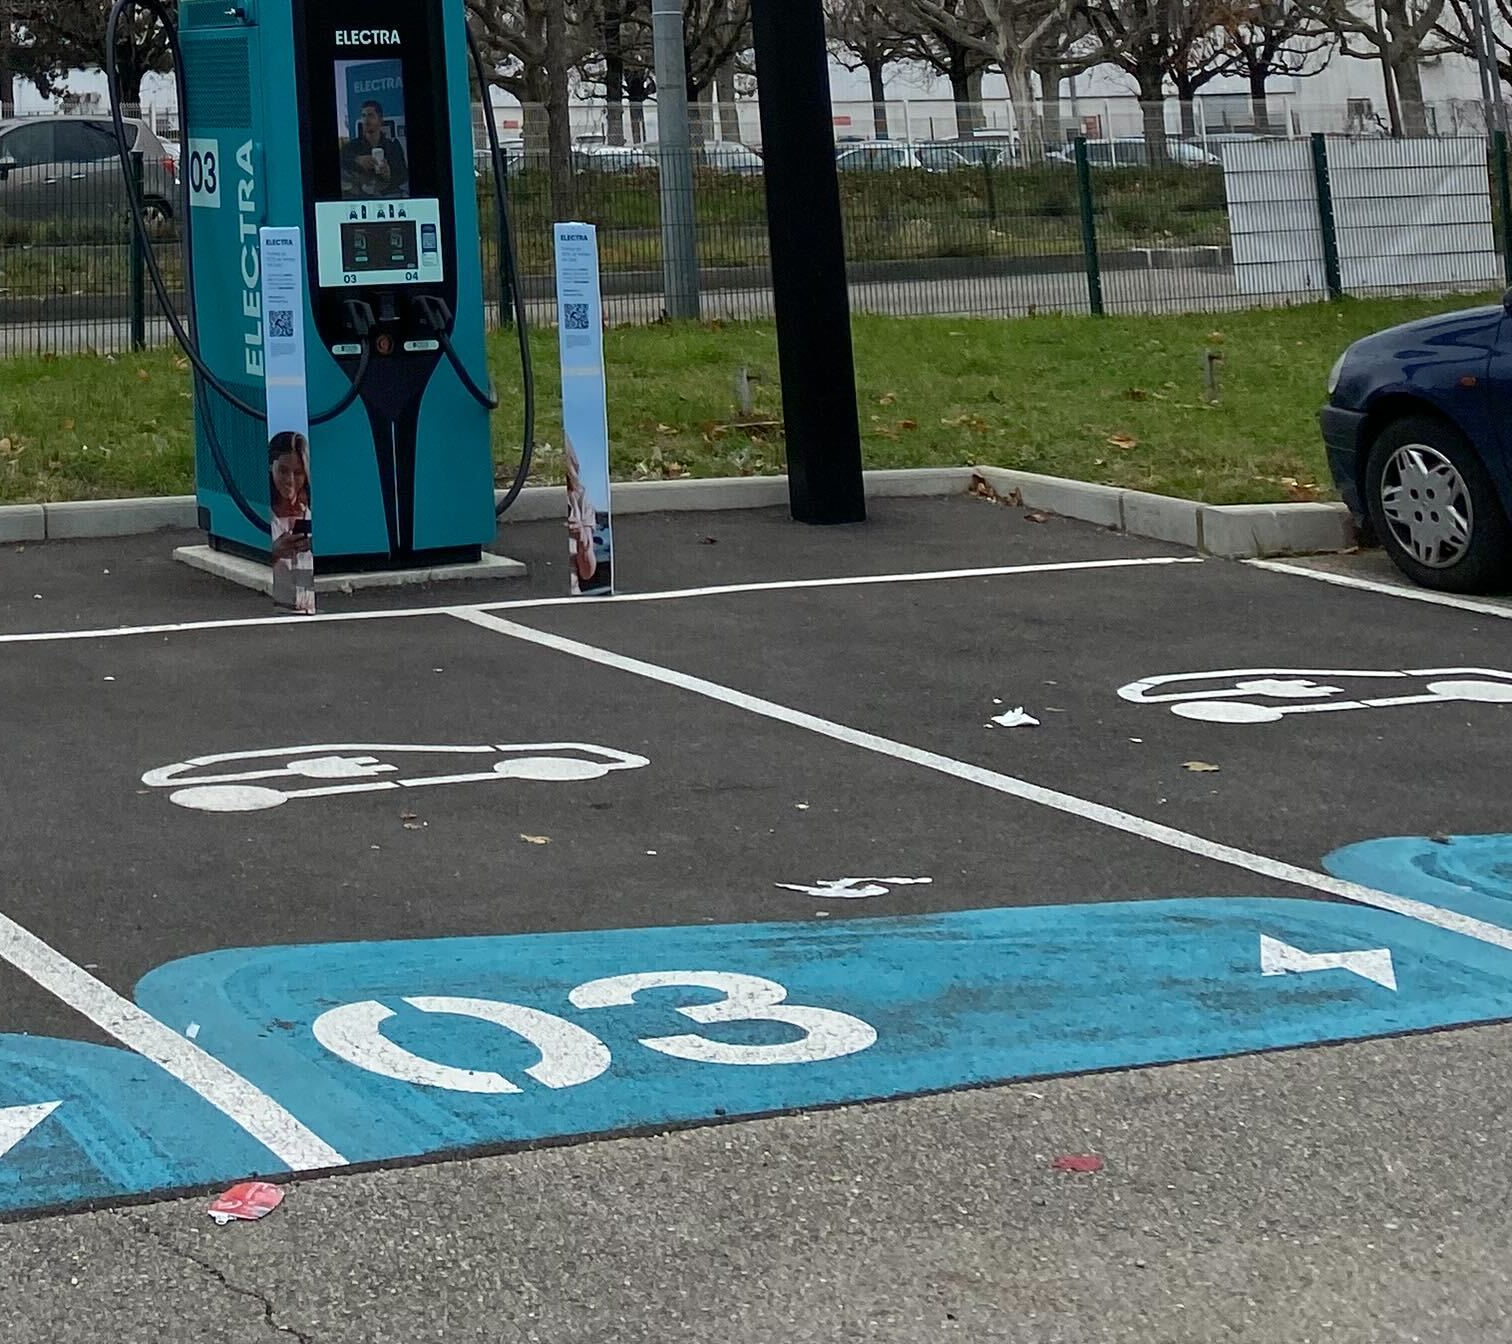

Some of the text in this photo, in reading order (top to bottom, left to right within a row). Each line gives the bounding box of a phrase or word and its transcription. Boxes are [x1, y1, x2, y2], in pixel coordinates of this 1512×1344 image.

[335, 30, 401, 45] ELECTRA
[354, 77, 403, 93] ELECTRA
[190, 151, 217, 194] 03
[236, 138, 265, 377] ELECTRA
[344, 274, 356, 283] 03
[405, 272, 418, 281] 04
[312, 970, 878, 1094] 03
